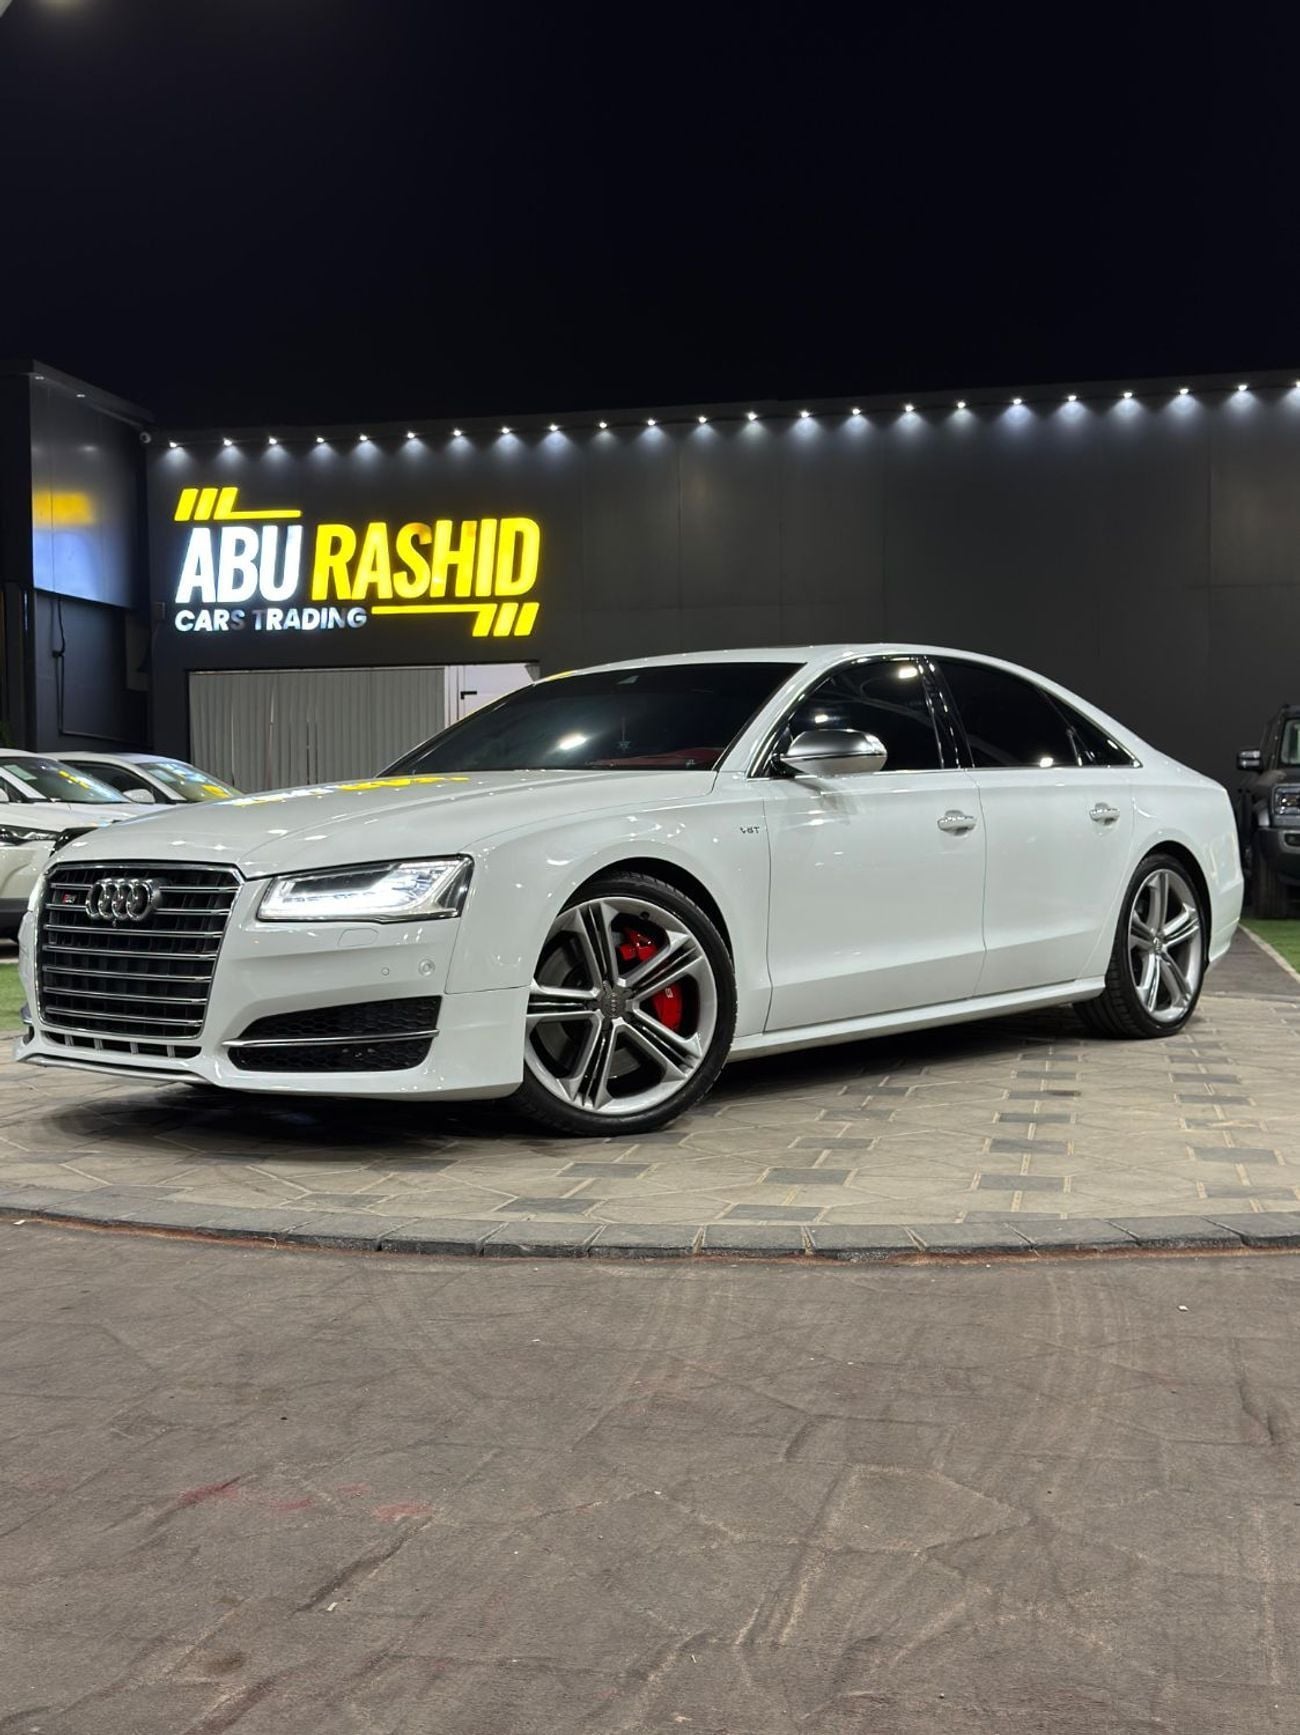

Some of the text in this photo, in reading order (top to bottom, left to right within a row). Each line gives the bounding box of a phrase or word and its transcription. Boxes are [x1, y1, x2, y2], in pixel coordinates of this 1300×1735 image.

[175, 517, 540, 604] ABU RASHID
[175, 607, 368, 632] CARS TRADING
